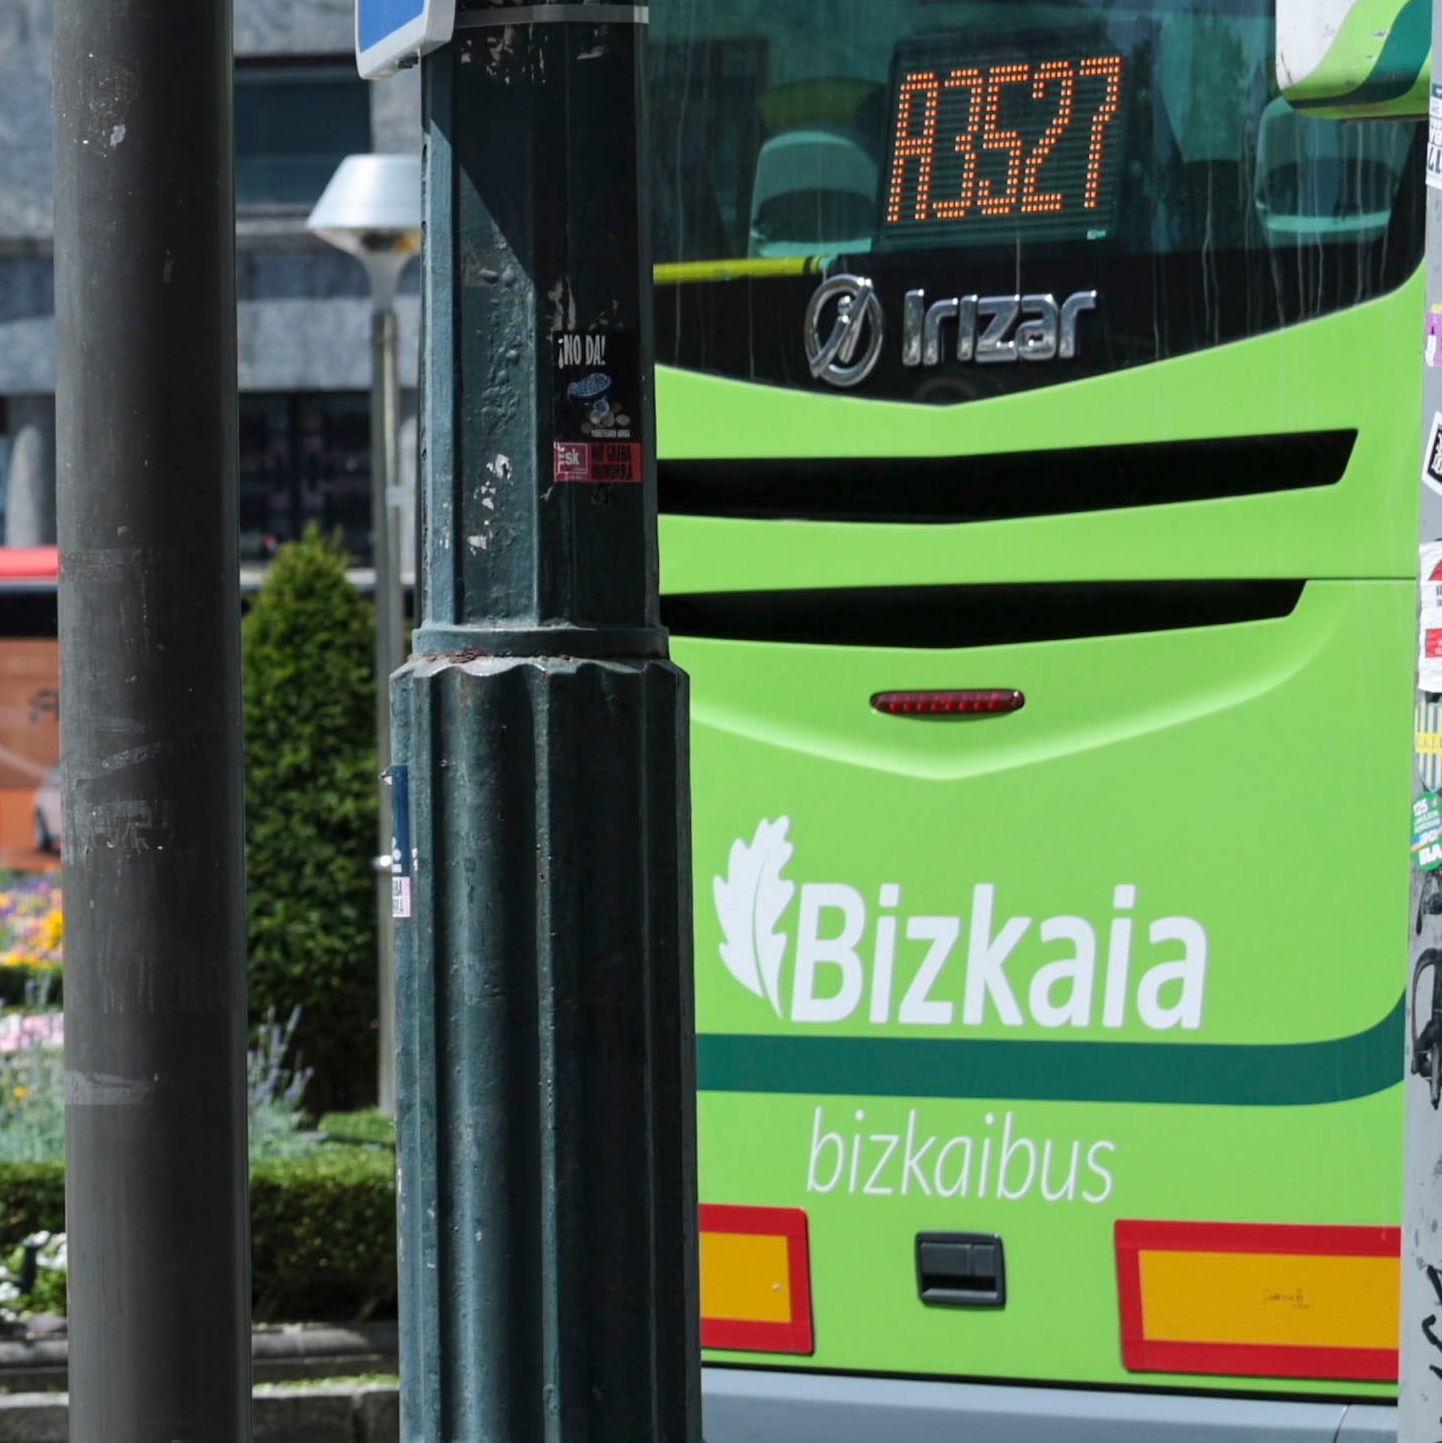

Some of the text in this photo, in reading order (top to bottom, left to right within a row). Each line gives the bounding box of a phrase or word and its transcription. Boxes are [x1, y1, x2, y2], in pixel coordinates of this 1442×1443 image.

[886, 55, 1122, 222] A3527
[558, 334, 606, 369] ¡NO DA!
[790, 883, 1208, 1031] Bizkaia
[805, 1107, 1117, 1203] bizkaibus
